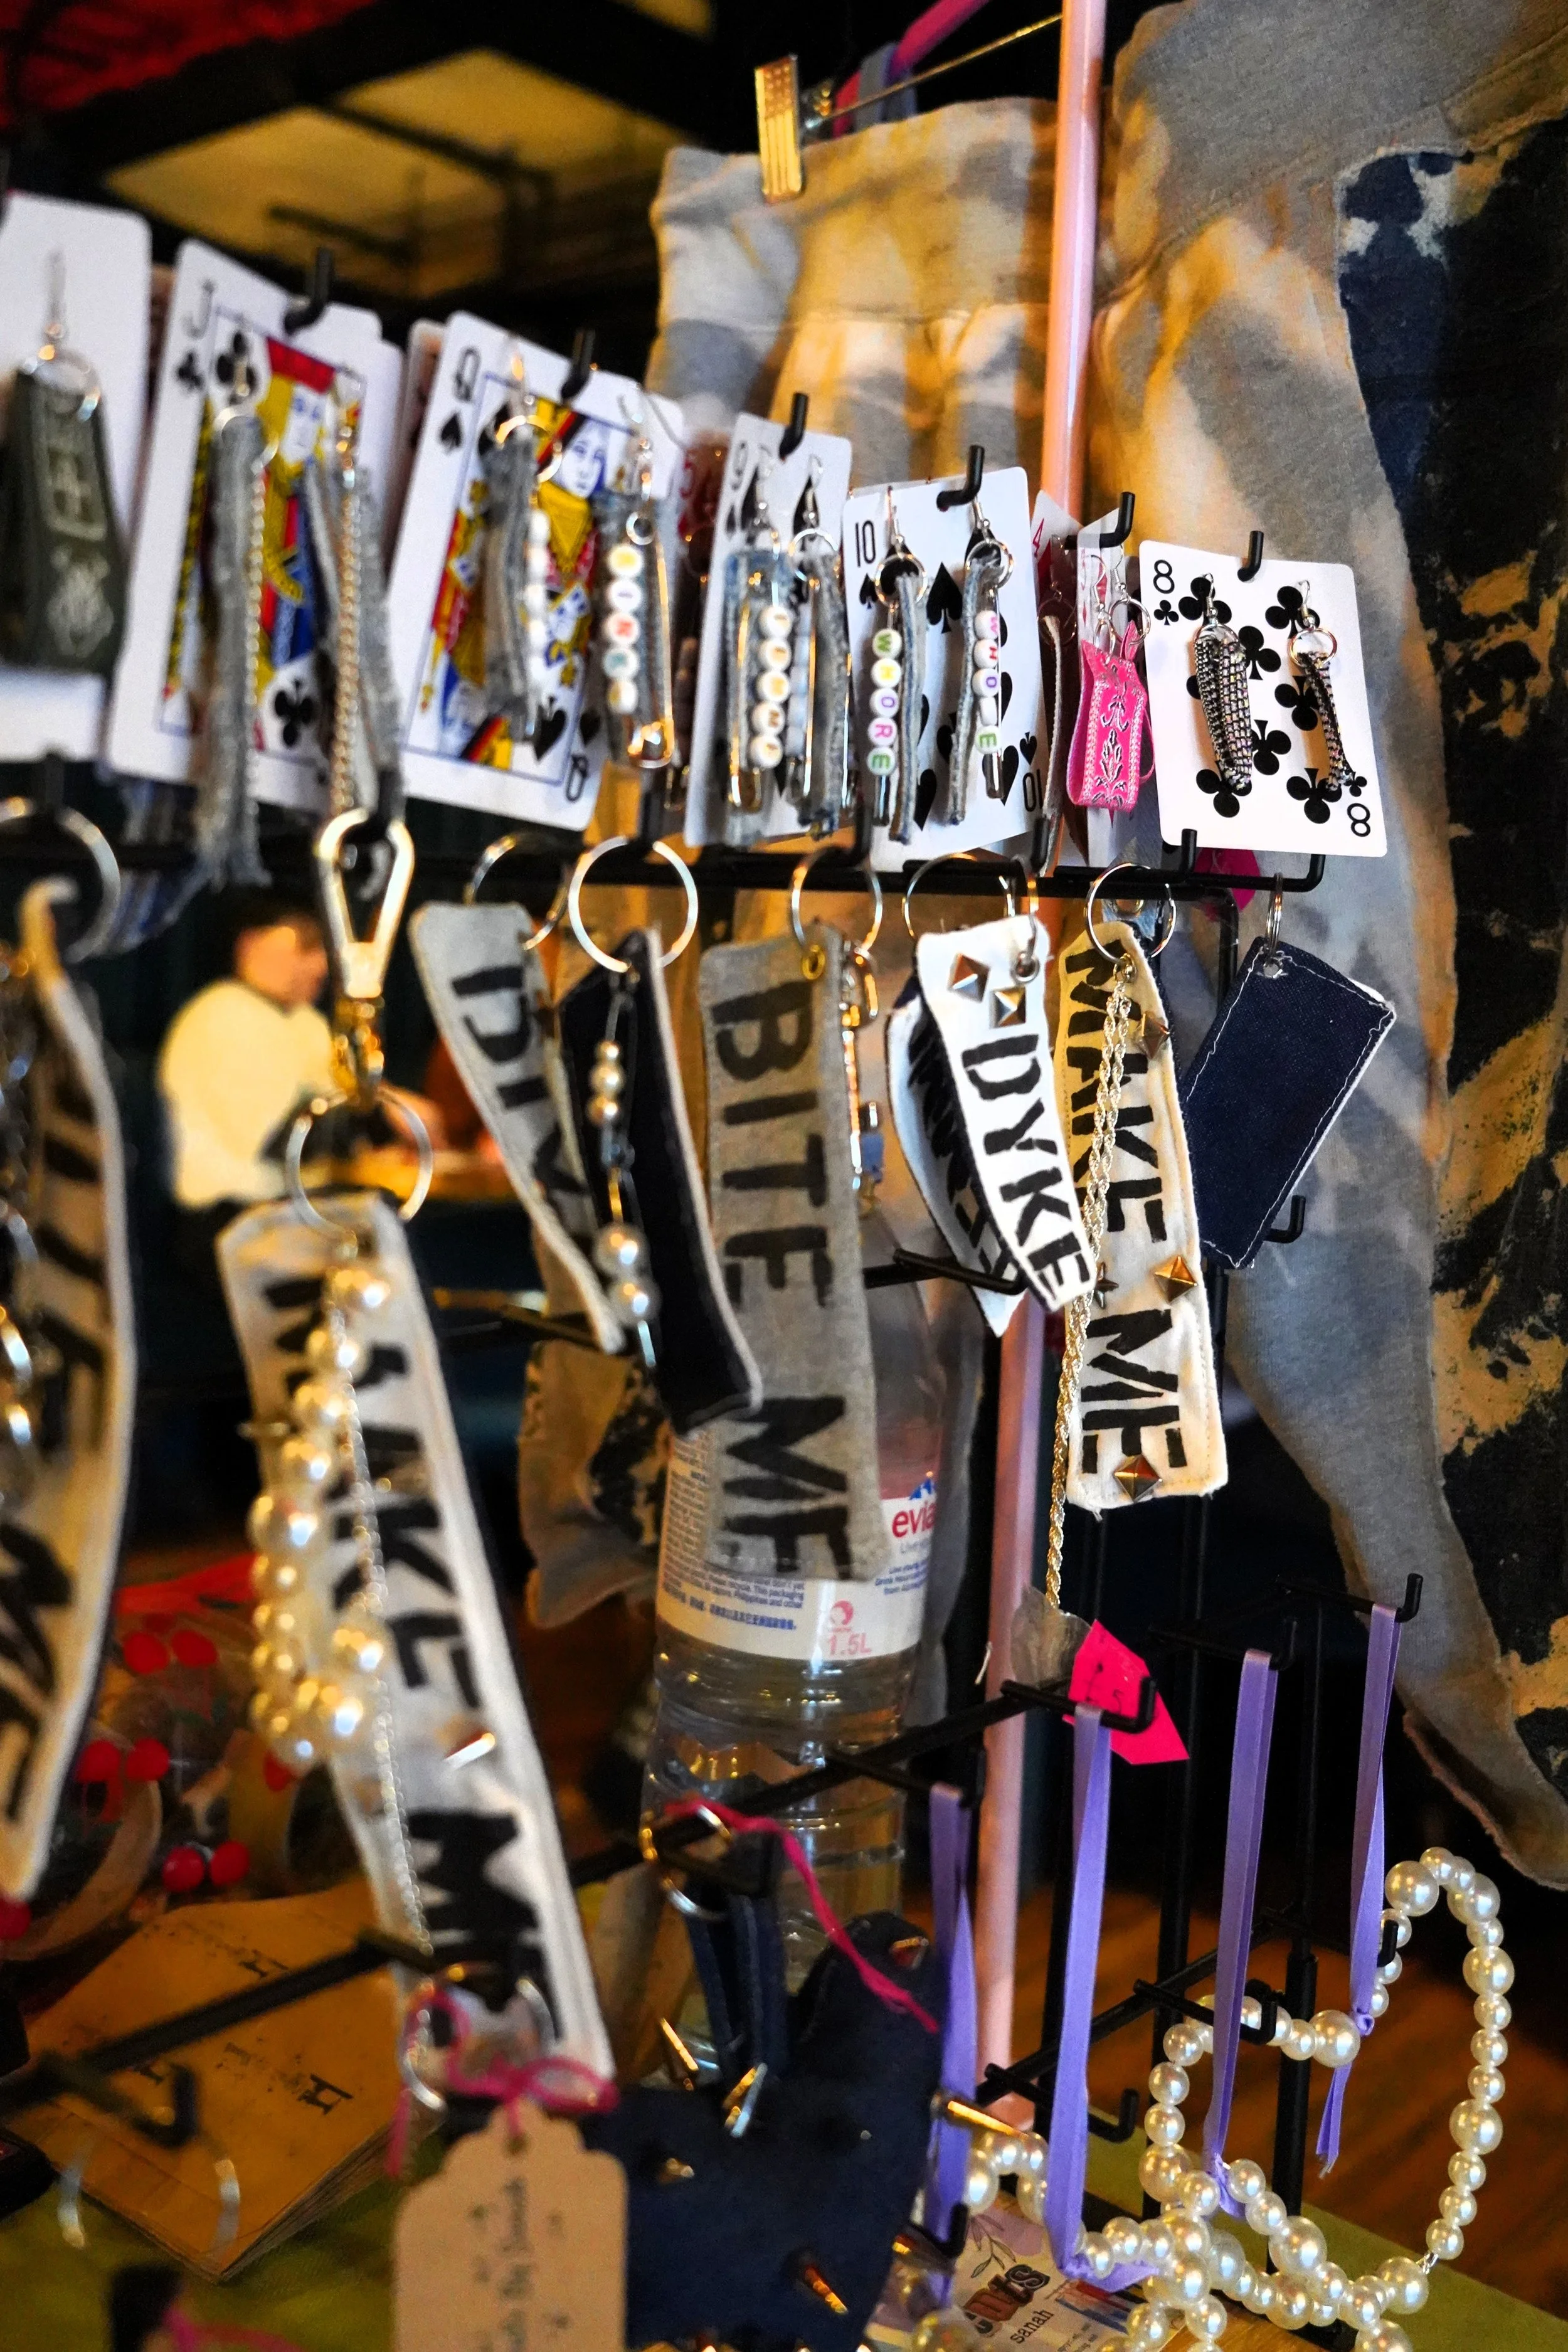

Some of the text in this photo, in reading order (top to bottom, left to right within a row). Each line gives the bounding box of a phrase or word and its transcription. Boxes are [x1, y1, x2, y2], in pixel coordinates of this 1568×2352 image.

[455, 346, 481, 402] Q
[855, 520, 876, 568] 10
[1032, 518, 1044, 557] 4
[1153, 559, 1175, 593] 8
[872, 632, 896, 770] WHORE
[979, 616, 999, 748] WHOE
[566, 755, 589, 802] Q
[1023, 769, 1043, 812] 10
[1347, 802, 1371, 837] 8
[710, 980, 833, 1313] BITE
[961, 1034, 1091, 1306] DYKE
[1066, 940, 1187, 1475] MAKE ME
[721, 1396, 853, 1580] ME
[829, 1633, 872, 1655] 1.5L
[1010, 2309, 1054, 2344] sanah
